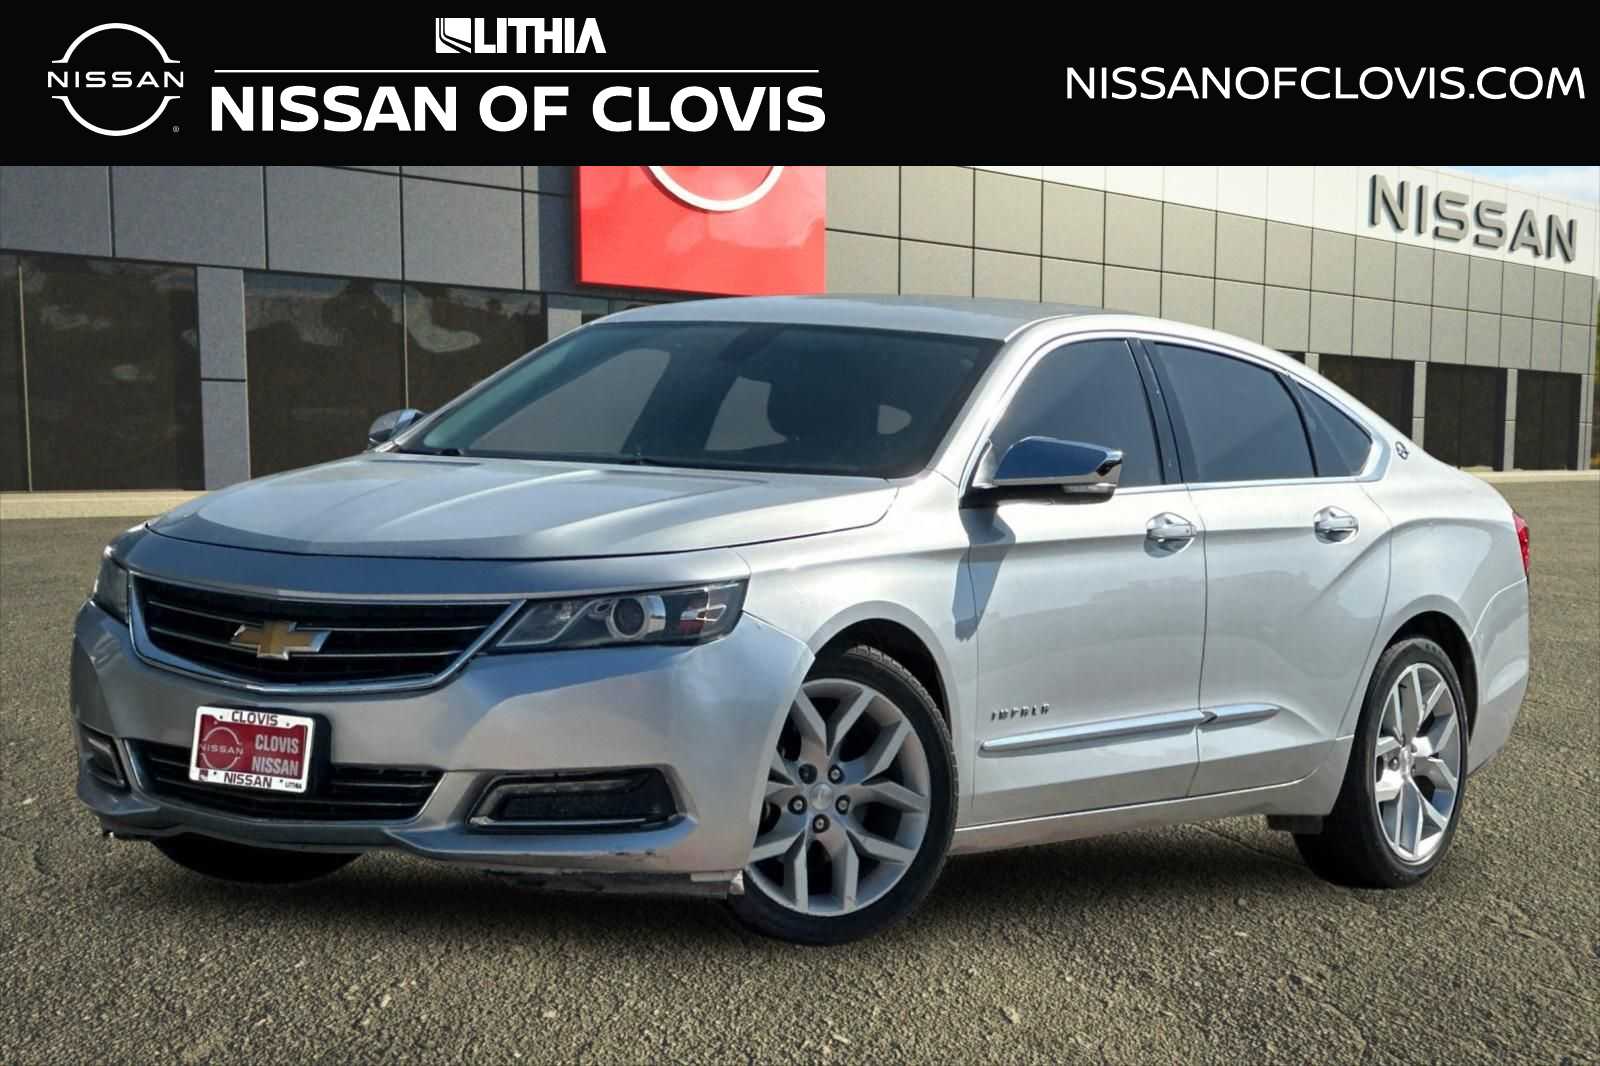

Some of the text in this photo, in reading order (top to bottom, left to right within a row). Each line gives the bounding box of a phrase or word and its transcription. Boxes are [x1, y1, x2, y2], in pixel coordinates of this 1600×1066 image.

[1369, 173, 1578, 264] NISSAN
[231, 711, 278, 726] CLOVIS
[200, 743, 244, 755] NISSAN
[255, 734, 299, 754] CLOVIS
[252, 756, 299, 776] NISSAN
[223, 772, 273, 788] NISSAN
